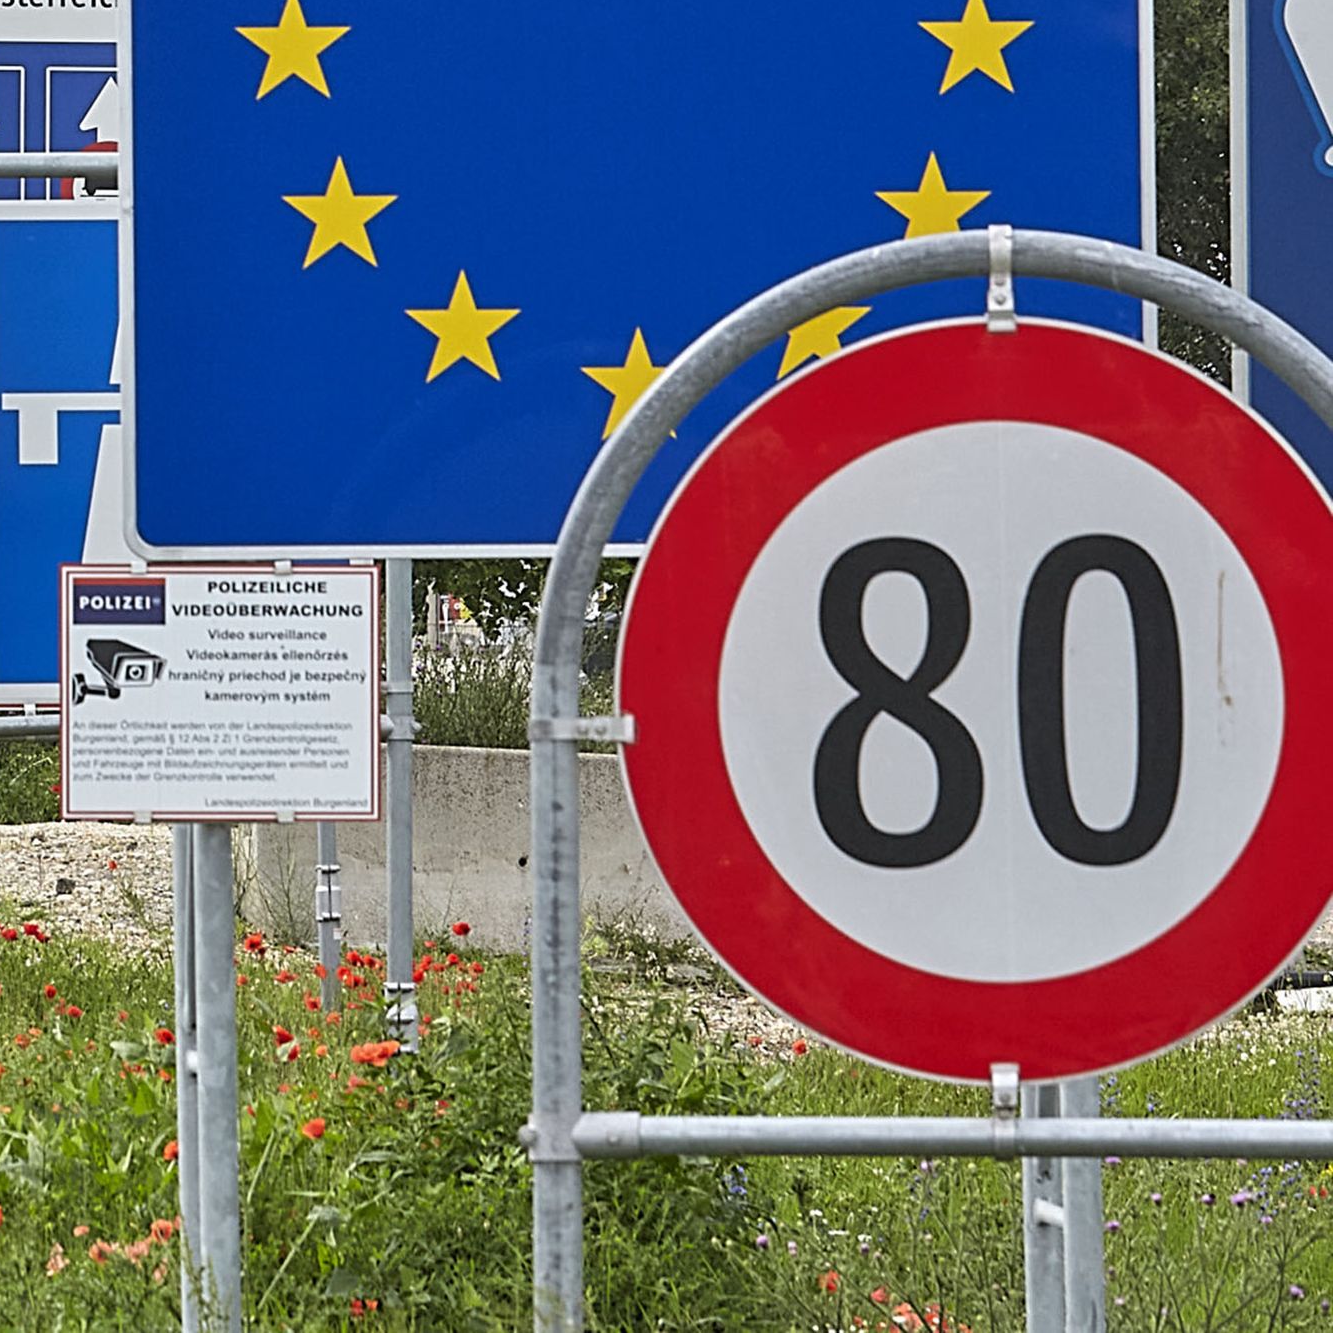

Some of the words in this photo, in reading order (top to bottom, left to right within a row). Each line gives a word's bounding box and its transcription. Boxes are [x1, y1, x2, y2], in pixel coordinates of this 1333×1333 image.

[207, 580, 328, 594] POLIZEILICHE
[79, 595, 151, 611] POLIZEI
[171, 602, 364, 617] VIDEOÜBERWACHUNG
[208, 629, 245, 641] Video
[249, 629, 327, 641] surveillance
[185, 648, 278, 661] Videokamerás
[168, 669, 224, 684] hraničný
[228, 669, 286, 684] priechod
[289, 669, 301, 684] je
[304, 669, 367, 684] bezpečný
[204, 690, 280, 704] kamerovým
[283, 690, 331, 704] systém
[813, 532, 1184, 868] 80
